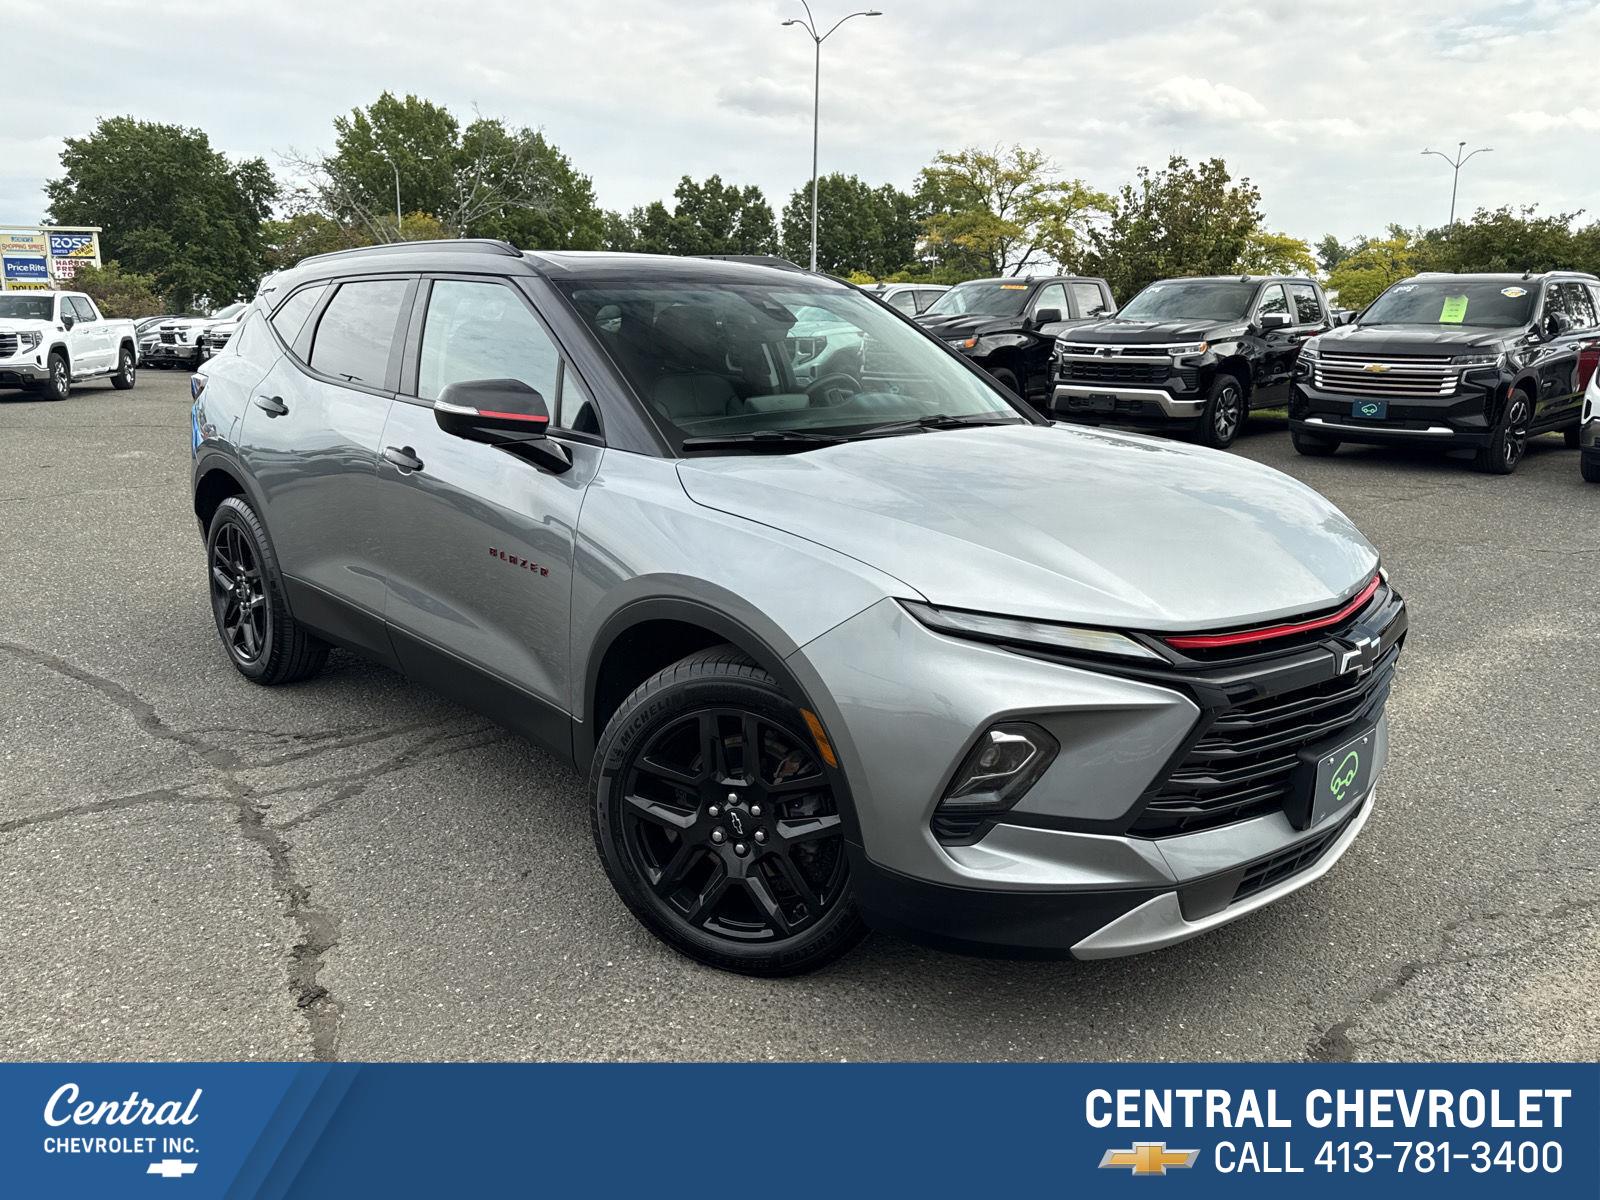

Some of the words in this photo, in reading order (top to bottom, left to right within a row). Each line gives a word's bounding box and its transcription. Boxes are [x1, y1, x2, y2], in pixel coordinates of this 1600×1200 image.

[51, 237, 91, 249] ROSS
[489, 547, 549, 577] BLAZER
[620, 693, 683, 747] MICHELIN
